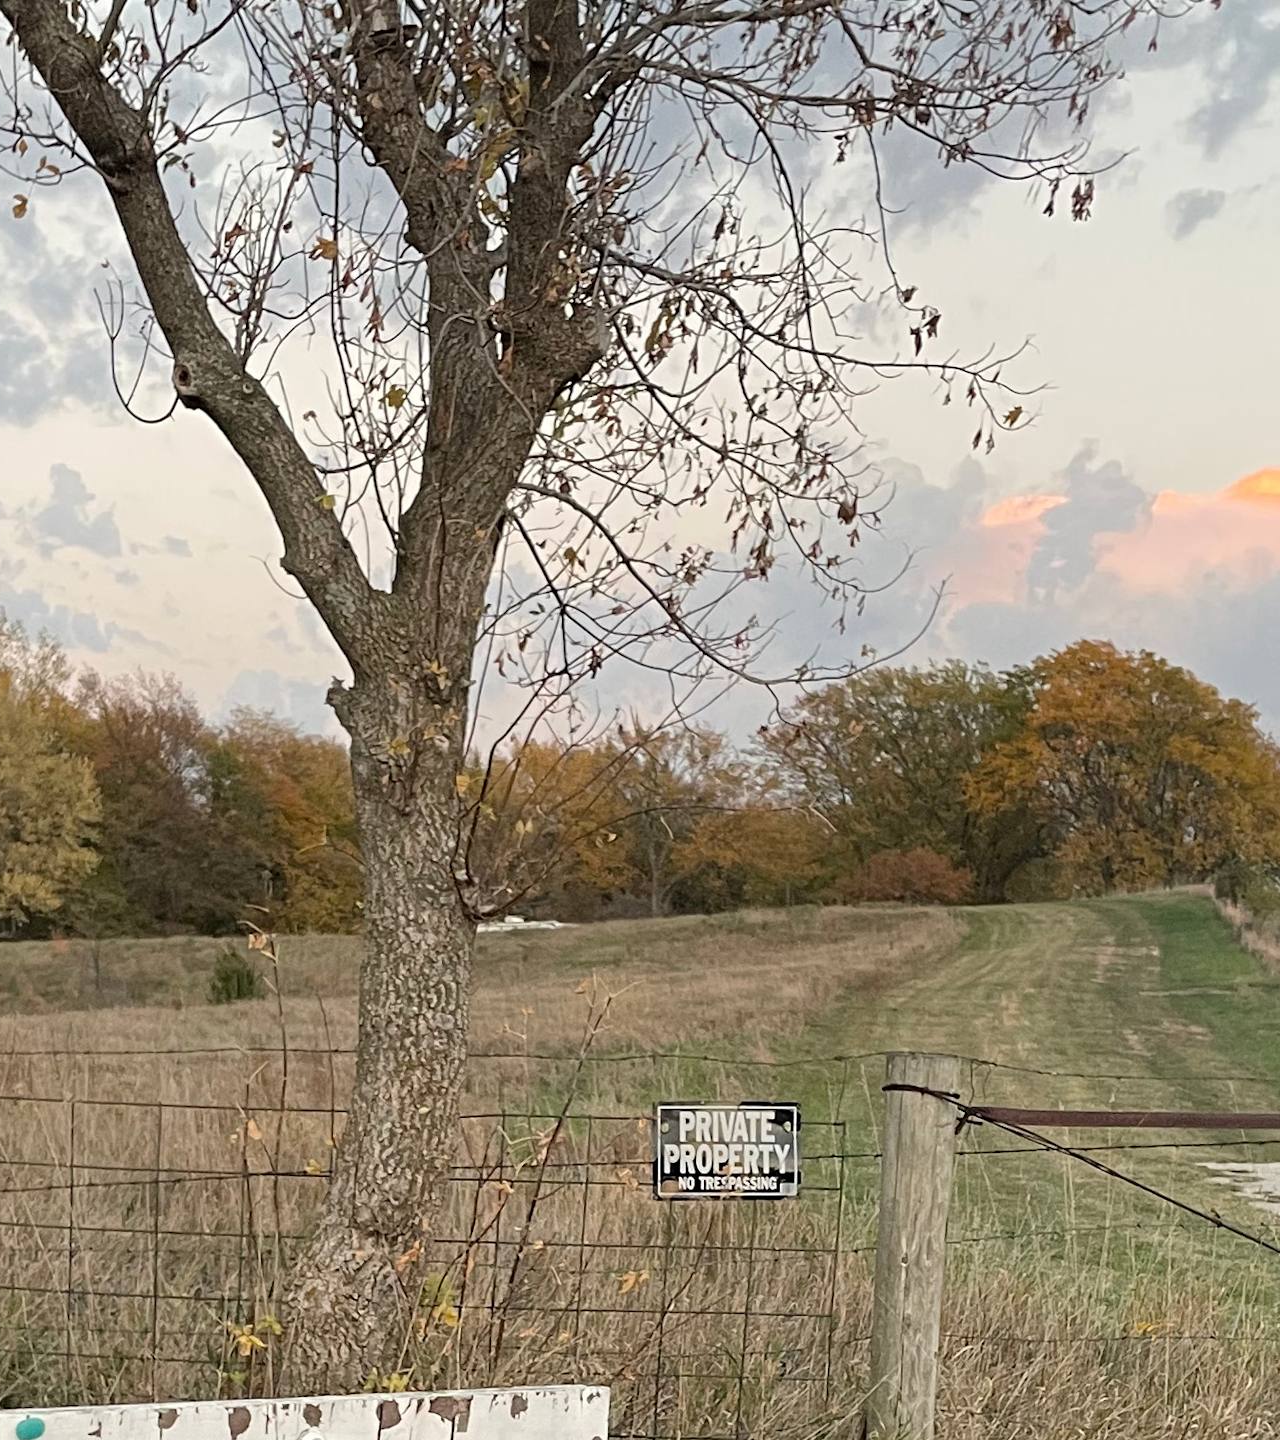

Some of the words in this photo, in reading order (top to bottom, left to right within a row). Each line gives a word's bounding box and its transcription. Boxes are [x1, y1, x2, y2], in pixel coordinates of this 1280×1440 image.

[678, 1110, 776, 1143] PRIVATE
[663, 1143, 791, 1175] PROPERTY
[678, 1176, 696, 1191] NO
[698, 1176, 778, 1191] TRESPASSING
